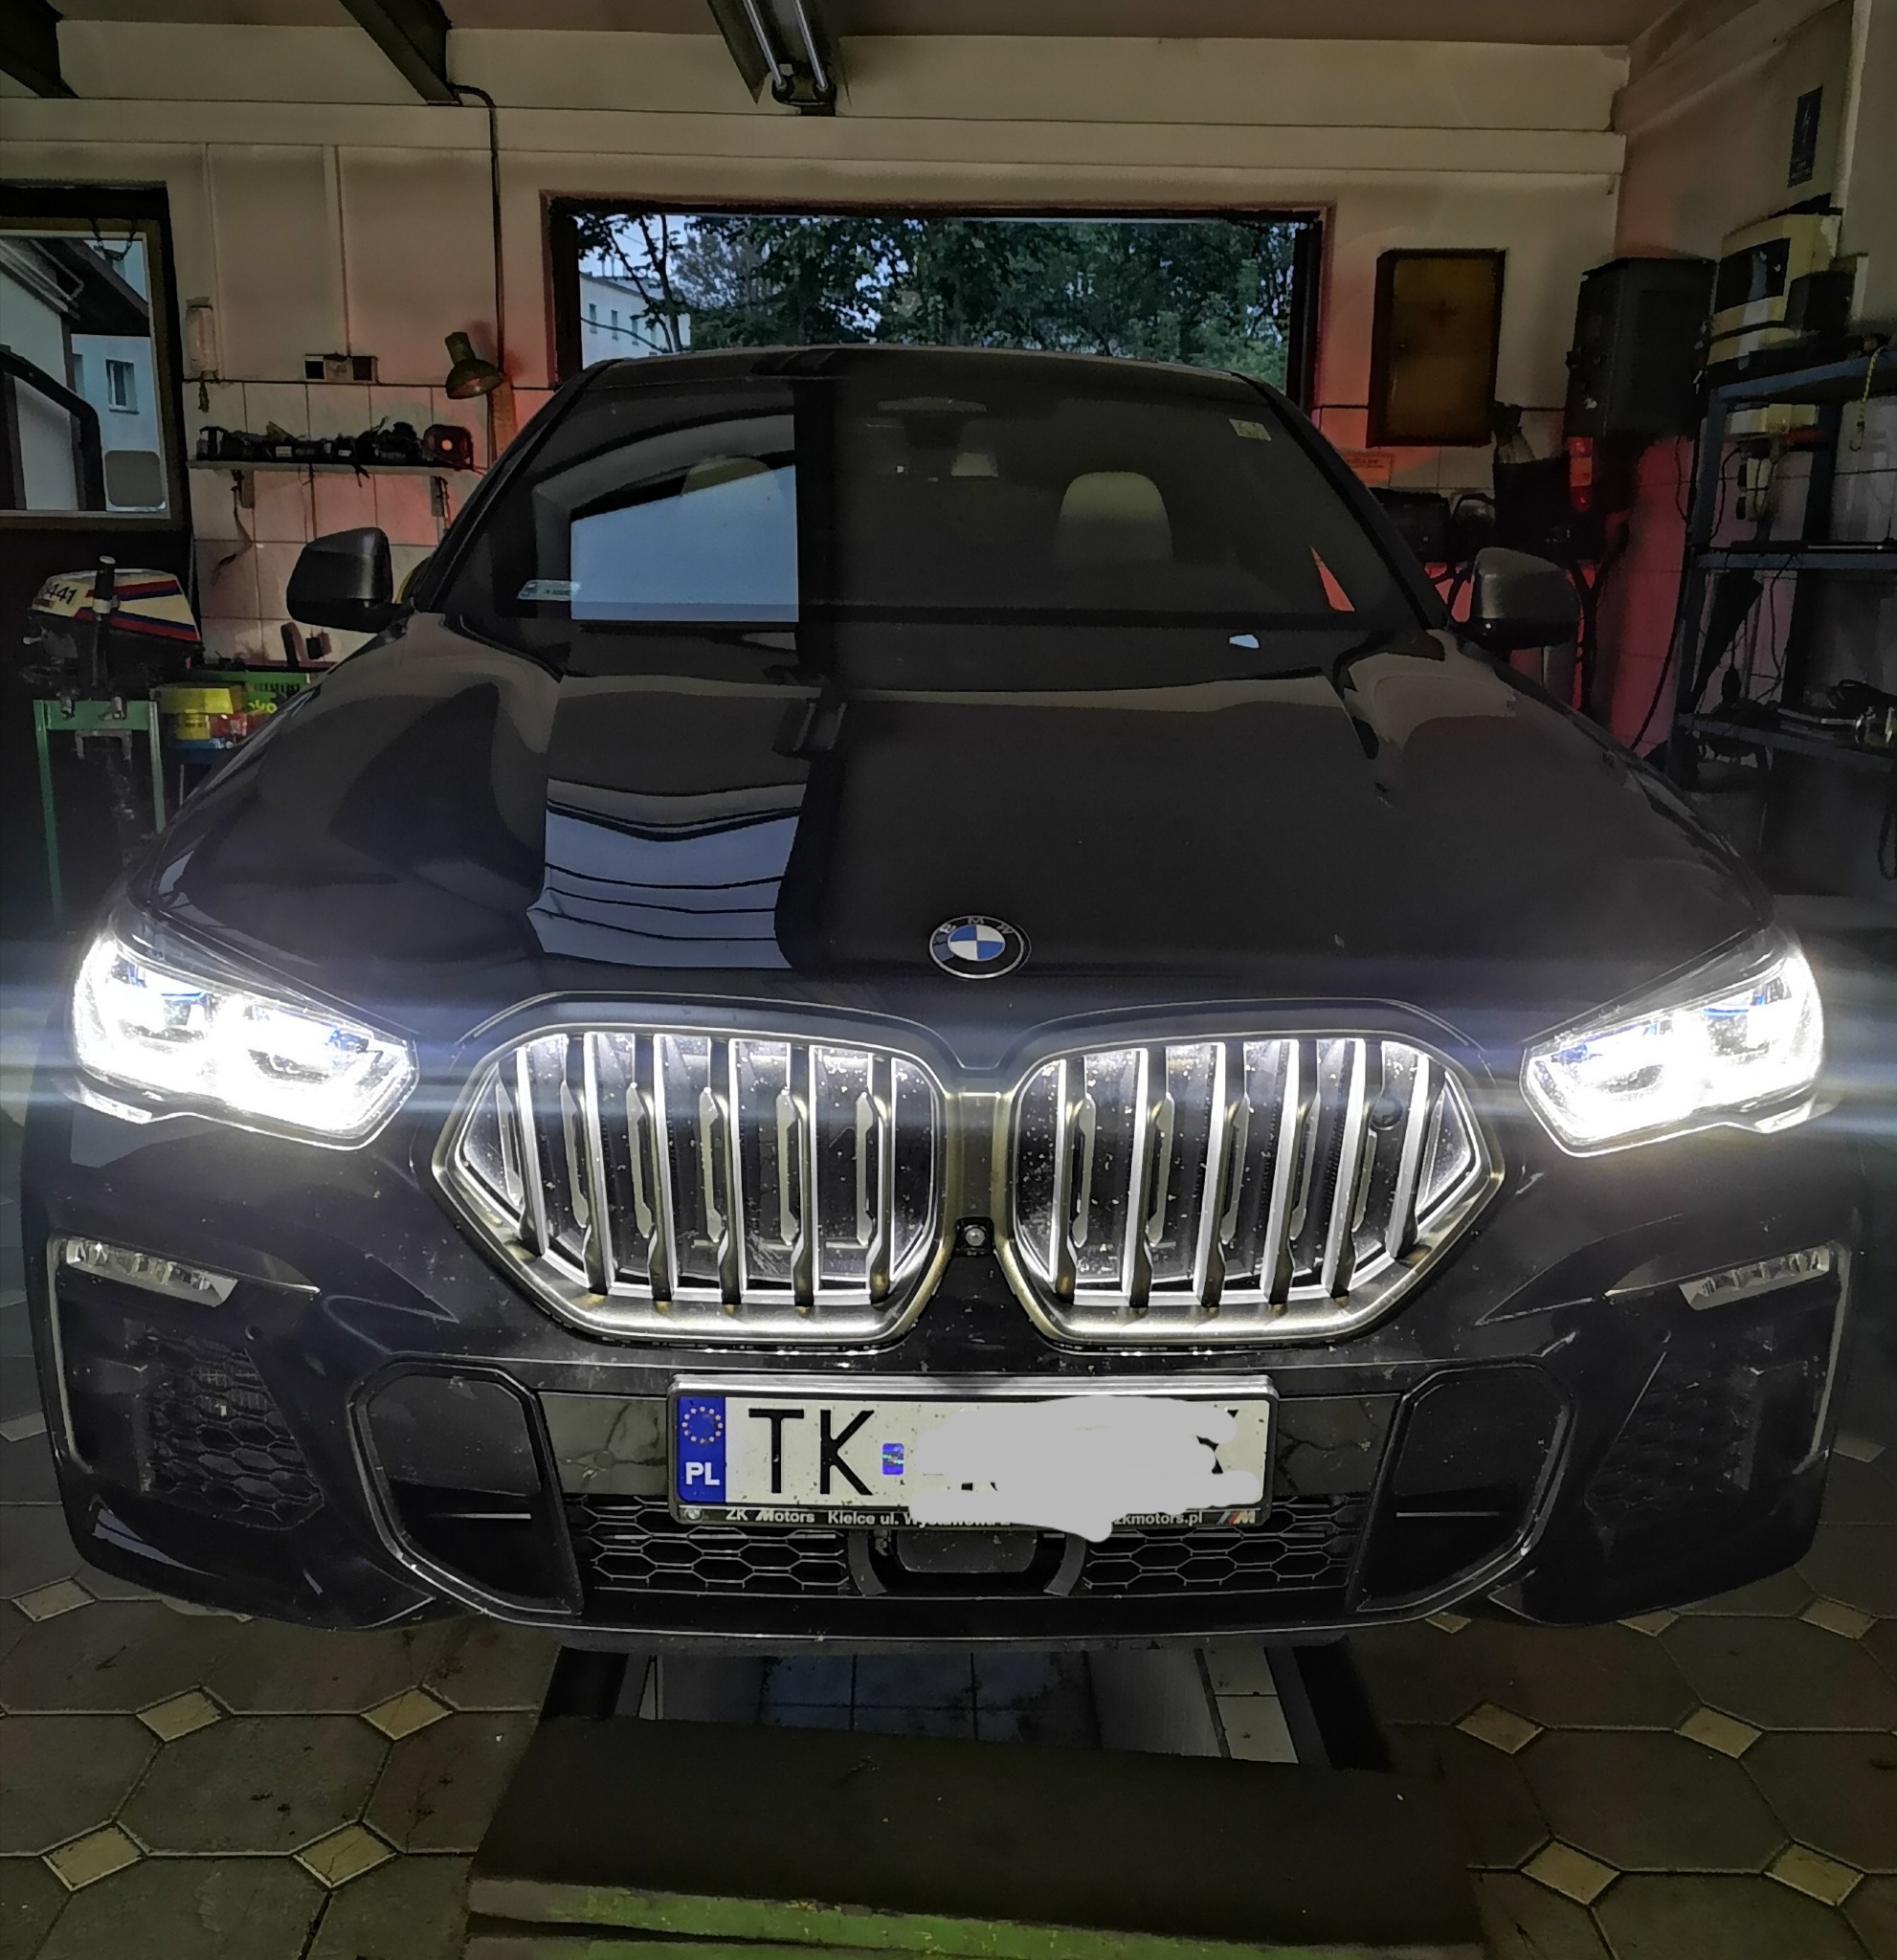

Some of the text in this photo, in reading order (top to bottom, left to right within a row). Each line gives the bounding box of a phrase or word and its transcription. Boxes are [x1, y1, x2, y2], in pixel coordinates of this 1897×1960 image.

[938, 916, 1015, 934] BMW
[748, 1408, 875, 1496] TK
[685, 1461, 721, 1485] PL
[725, 1508, 748, 1522] ZK
[755, 1508, 815, 1524] Motors
[828, 1511, 876, 1526] Kielce
[880, 1512, 899, 1526] ul.
